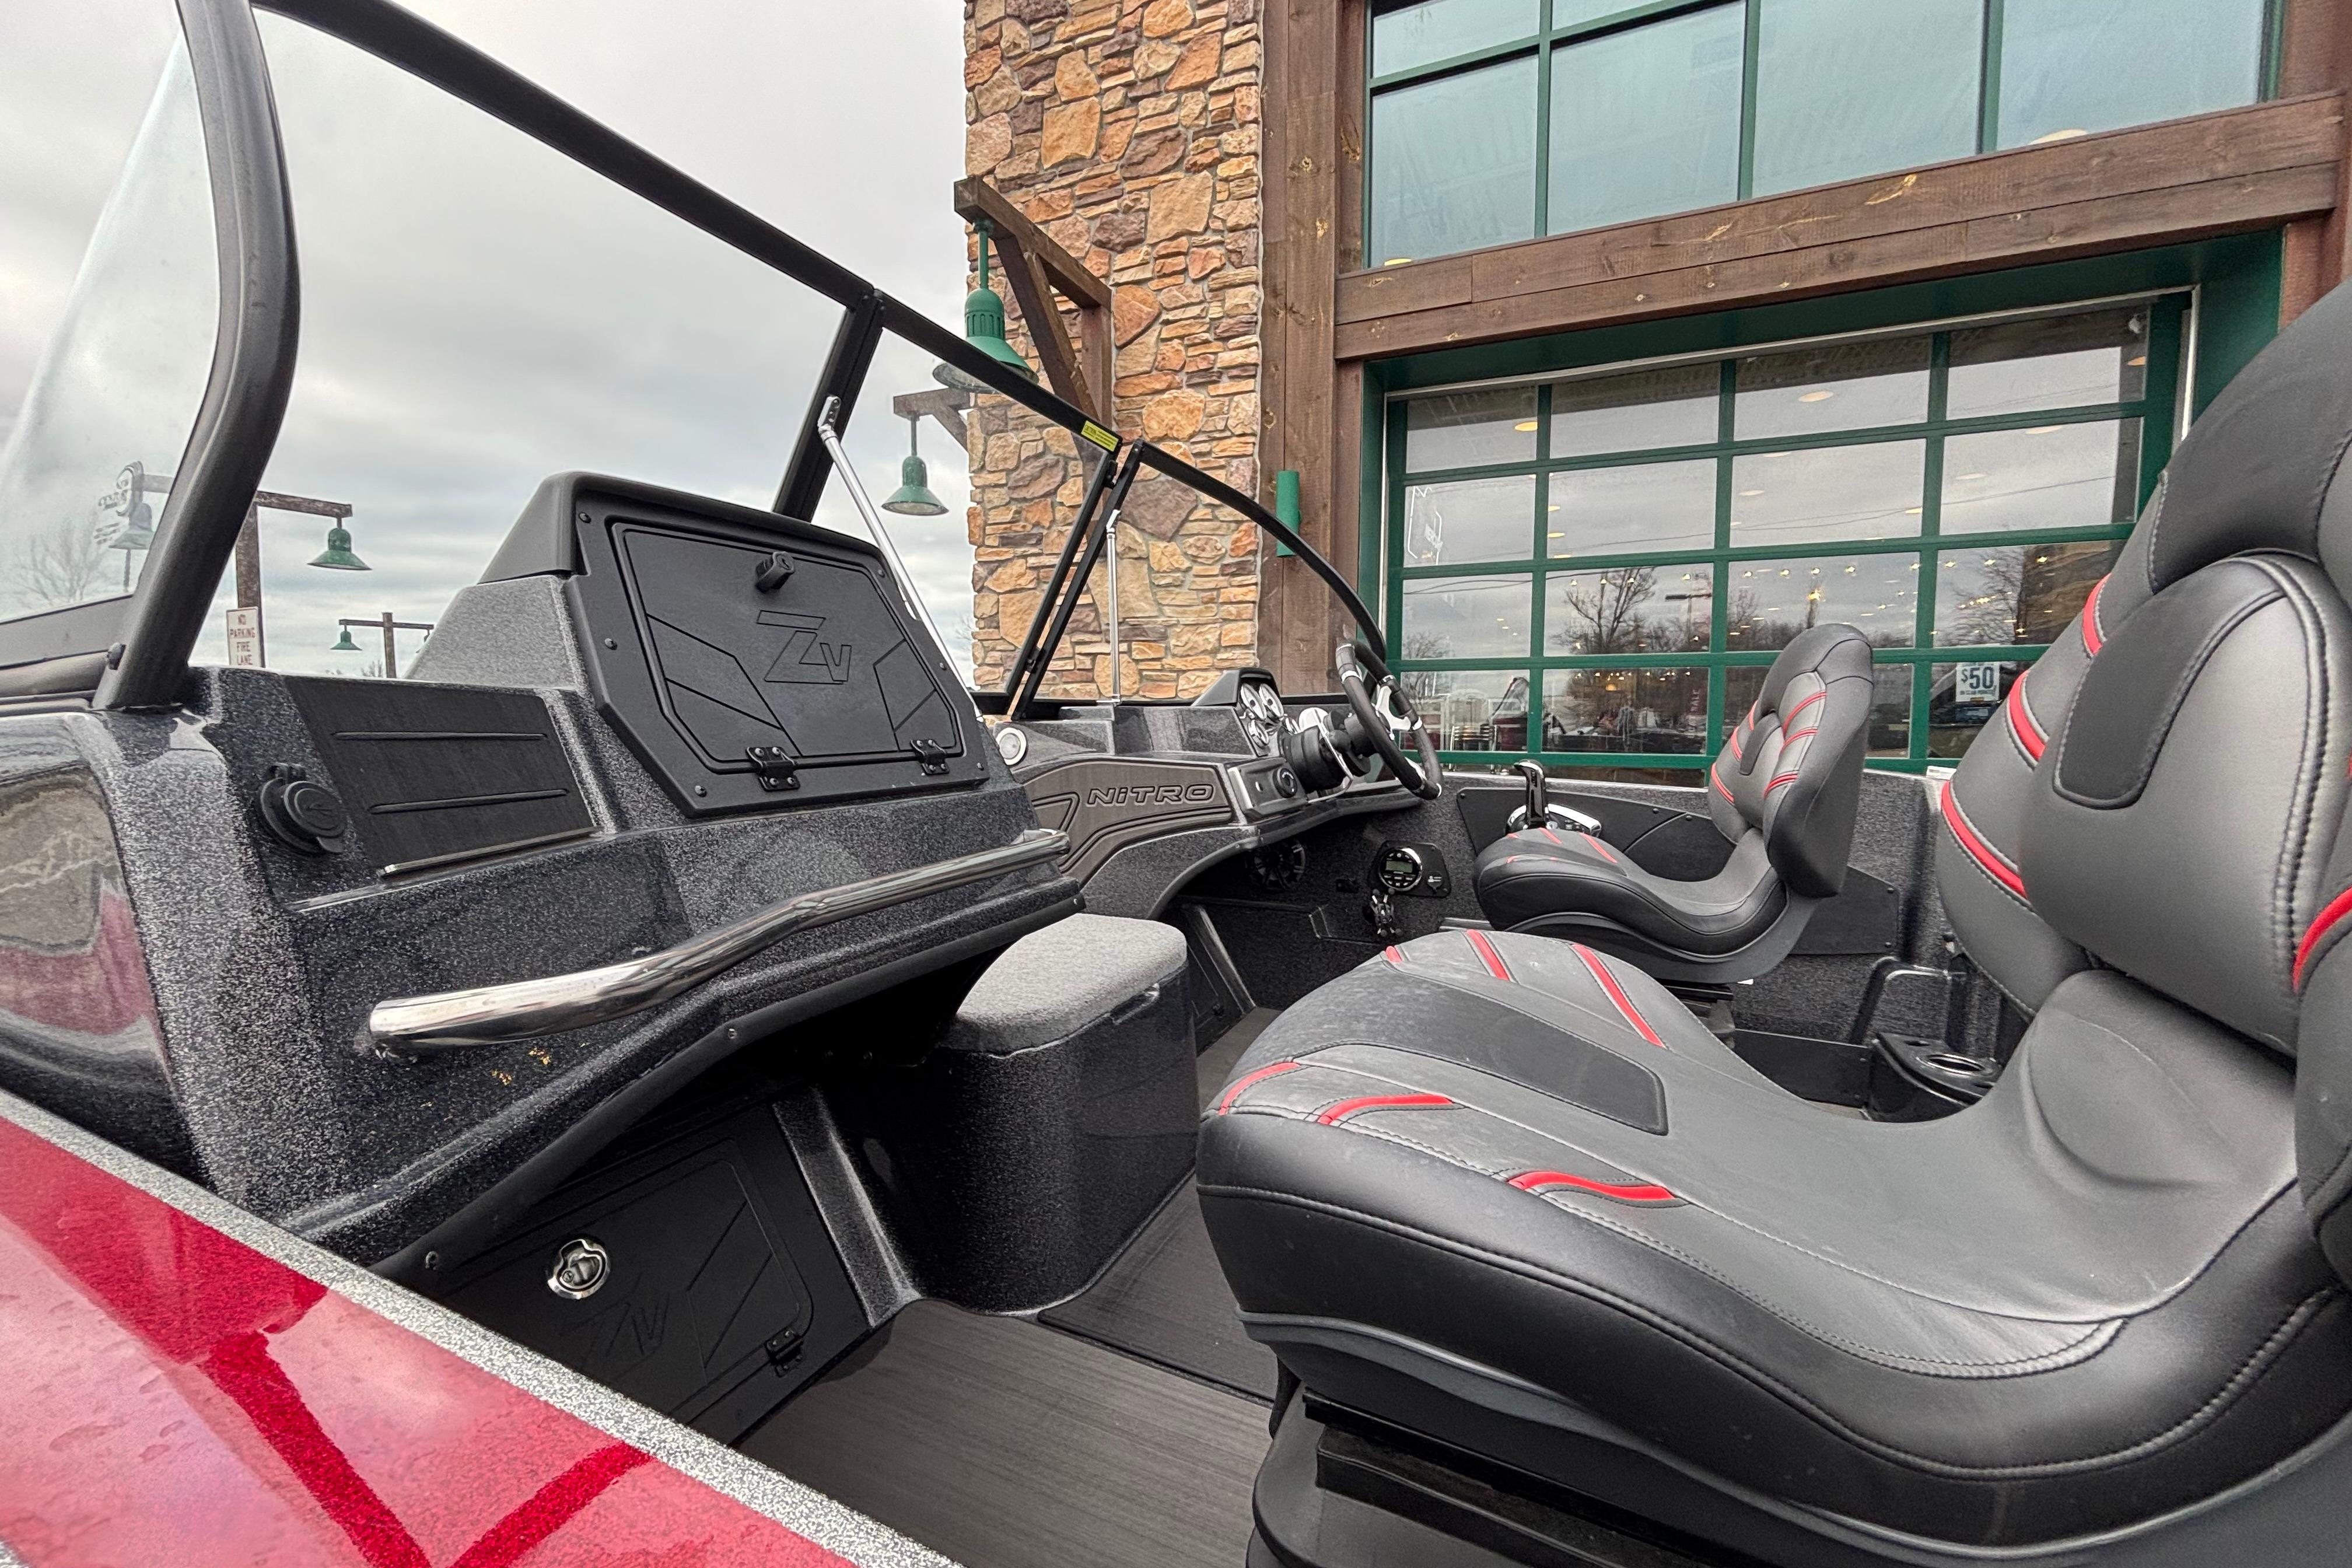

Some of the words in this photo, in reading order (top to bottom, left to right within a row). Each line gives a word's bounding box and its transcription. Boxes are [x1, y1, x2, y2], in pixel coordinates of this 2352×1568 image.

[230, 628, 255, 638] PARKING
[236, 642, 250, 652] FIRE
[237, 654, 253, 665] LANE
[1961, 666, 1994, 690] $50
